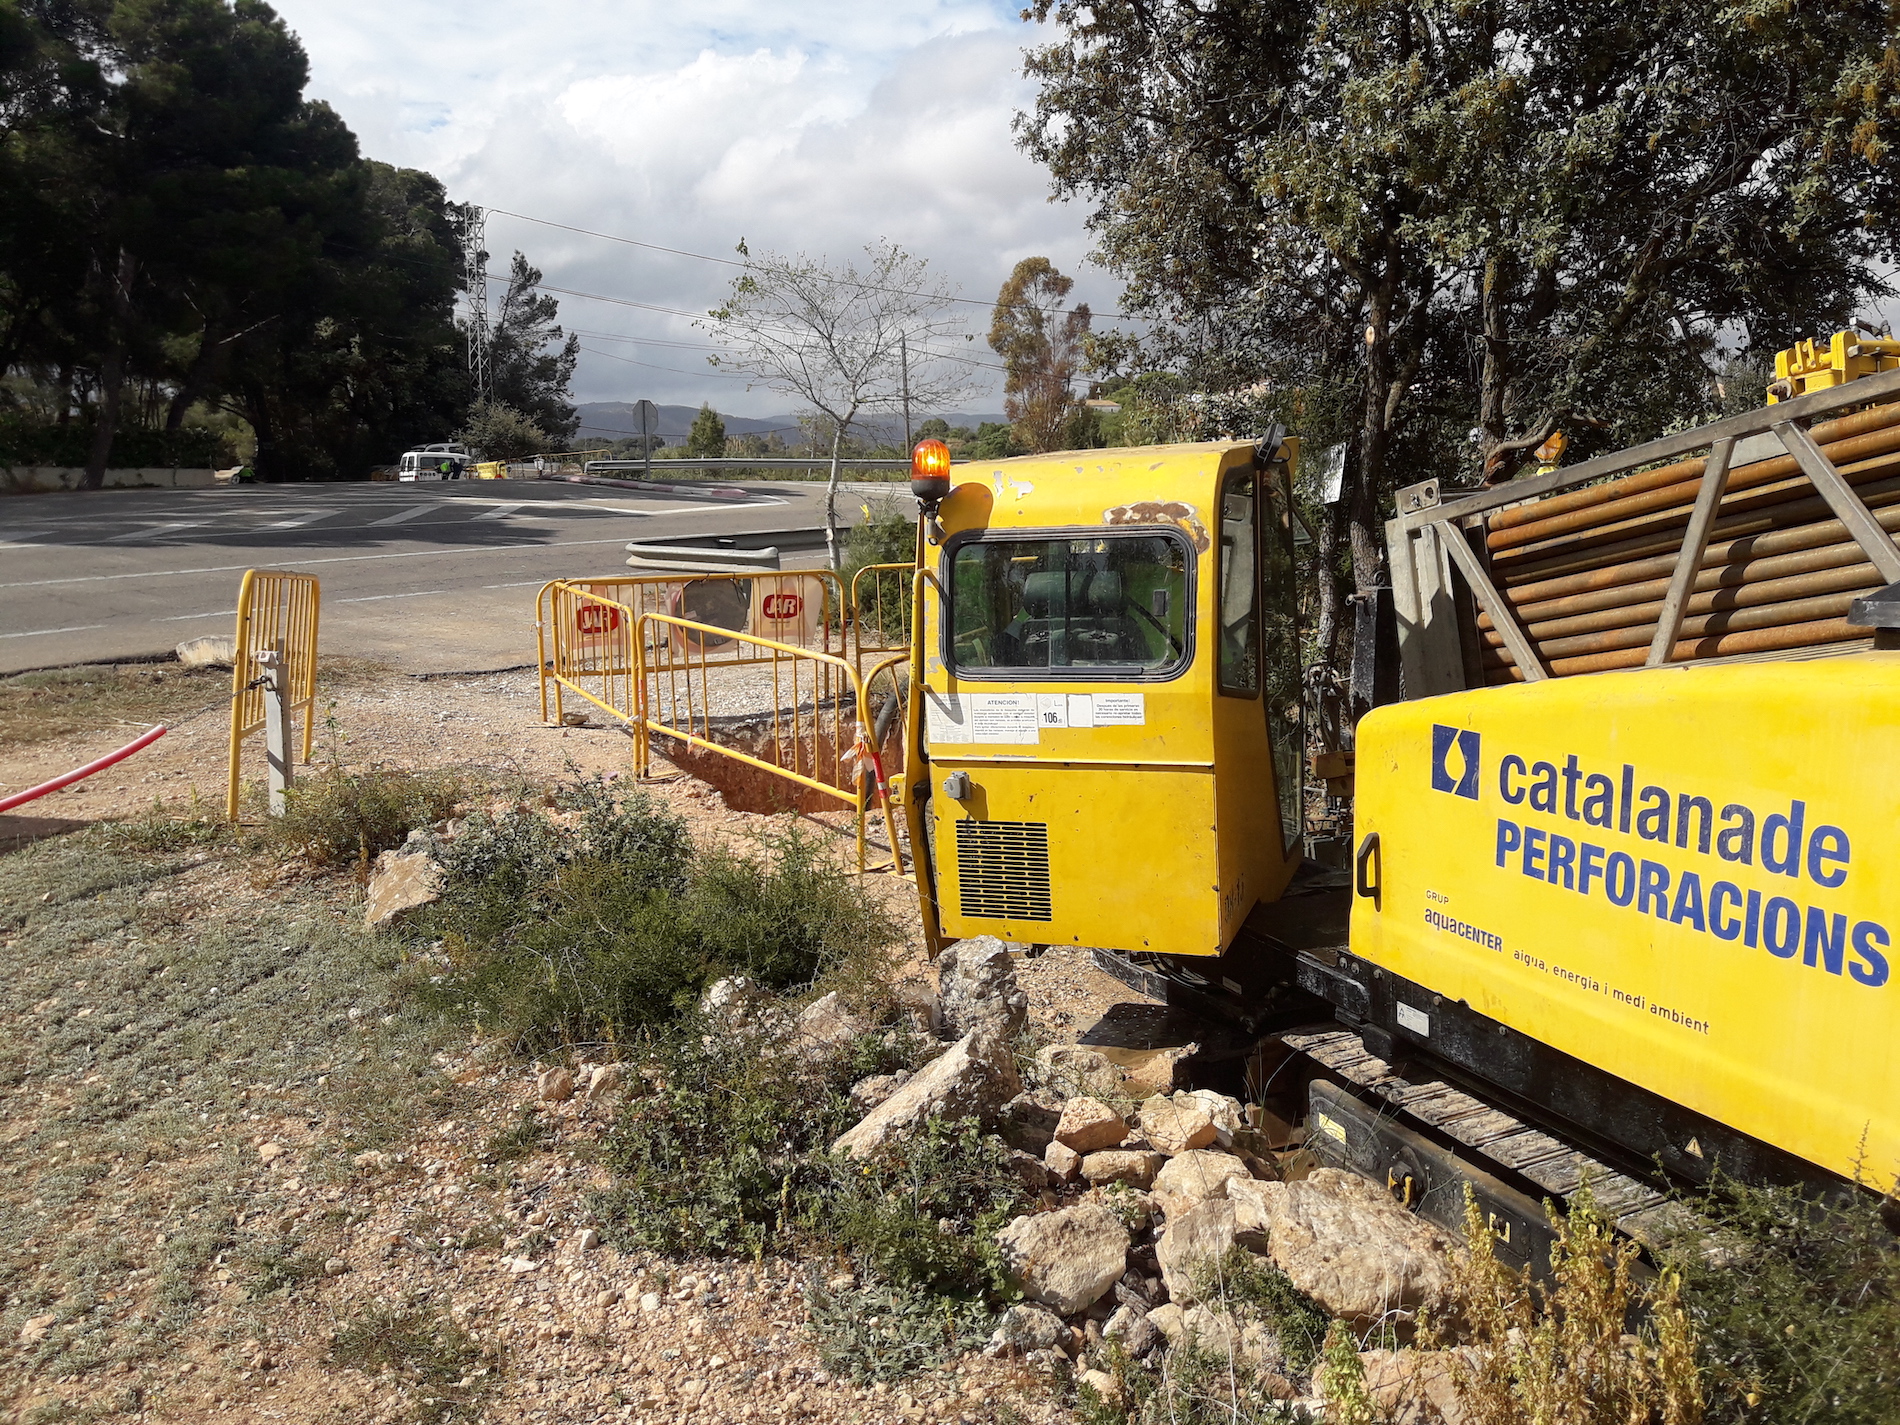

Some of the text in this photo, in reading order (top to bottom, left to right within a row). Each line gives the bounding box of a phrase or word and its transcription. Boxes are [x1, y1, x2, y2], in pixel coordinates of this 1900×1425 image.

[766, 598, 797, 615] JAR
[1043, 712, 1058, 724] 106
[1499, 753, 1851, 888] catalanade
[1425, 889, 1450, 905] GRUP
[1496, 818, 1890, 987] PERFORACIONS
[1424, 907, 1503, 953] aquaCENTER
[1553, 965, 1599, 992] energia
[1604, 982, 1608, 995] i
[1613, 988, 1645, 1009] medi
[1650, 1002, 1710, 1035] ambient
